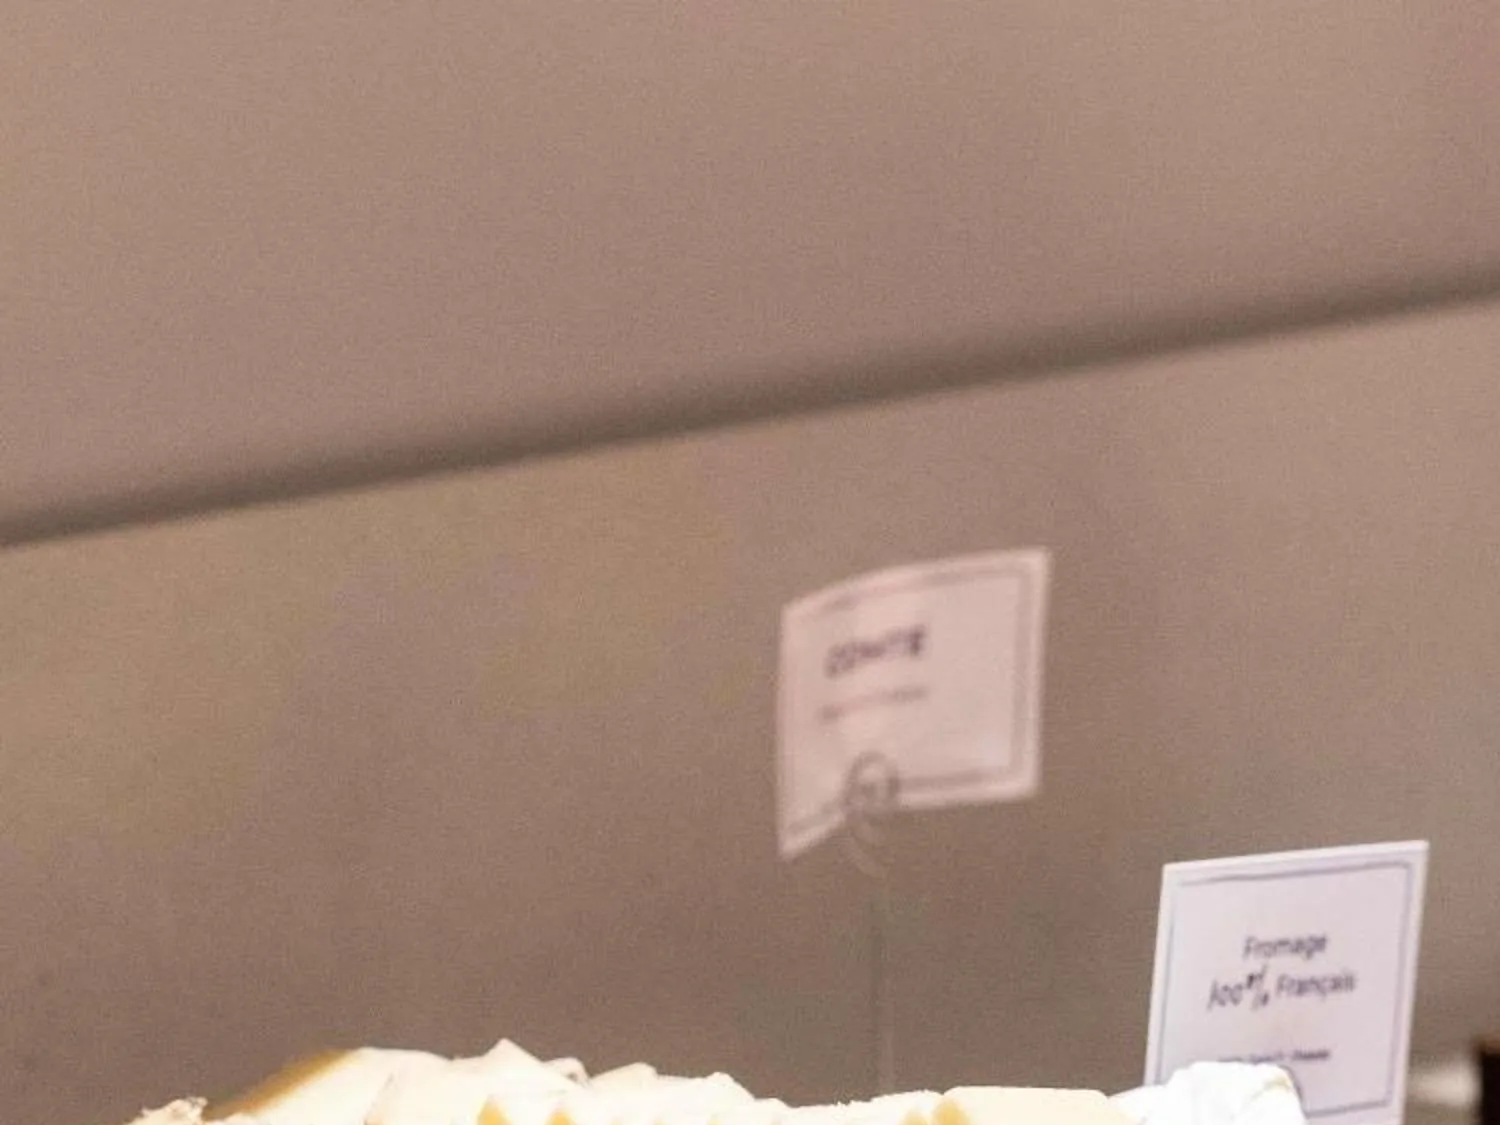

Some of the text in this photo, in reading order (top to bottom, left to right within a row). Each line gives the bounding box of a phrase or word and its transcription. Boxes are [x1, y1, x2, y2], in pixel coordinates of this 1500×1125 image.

[1244, 933, 1328, 961] Fromage
[1207, 964, 1356, 1012] 100% Français
